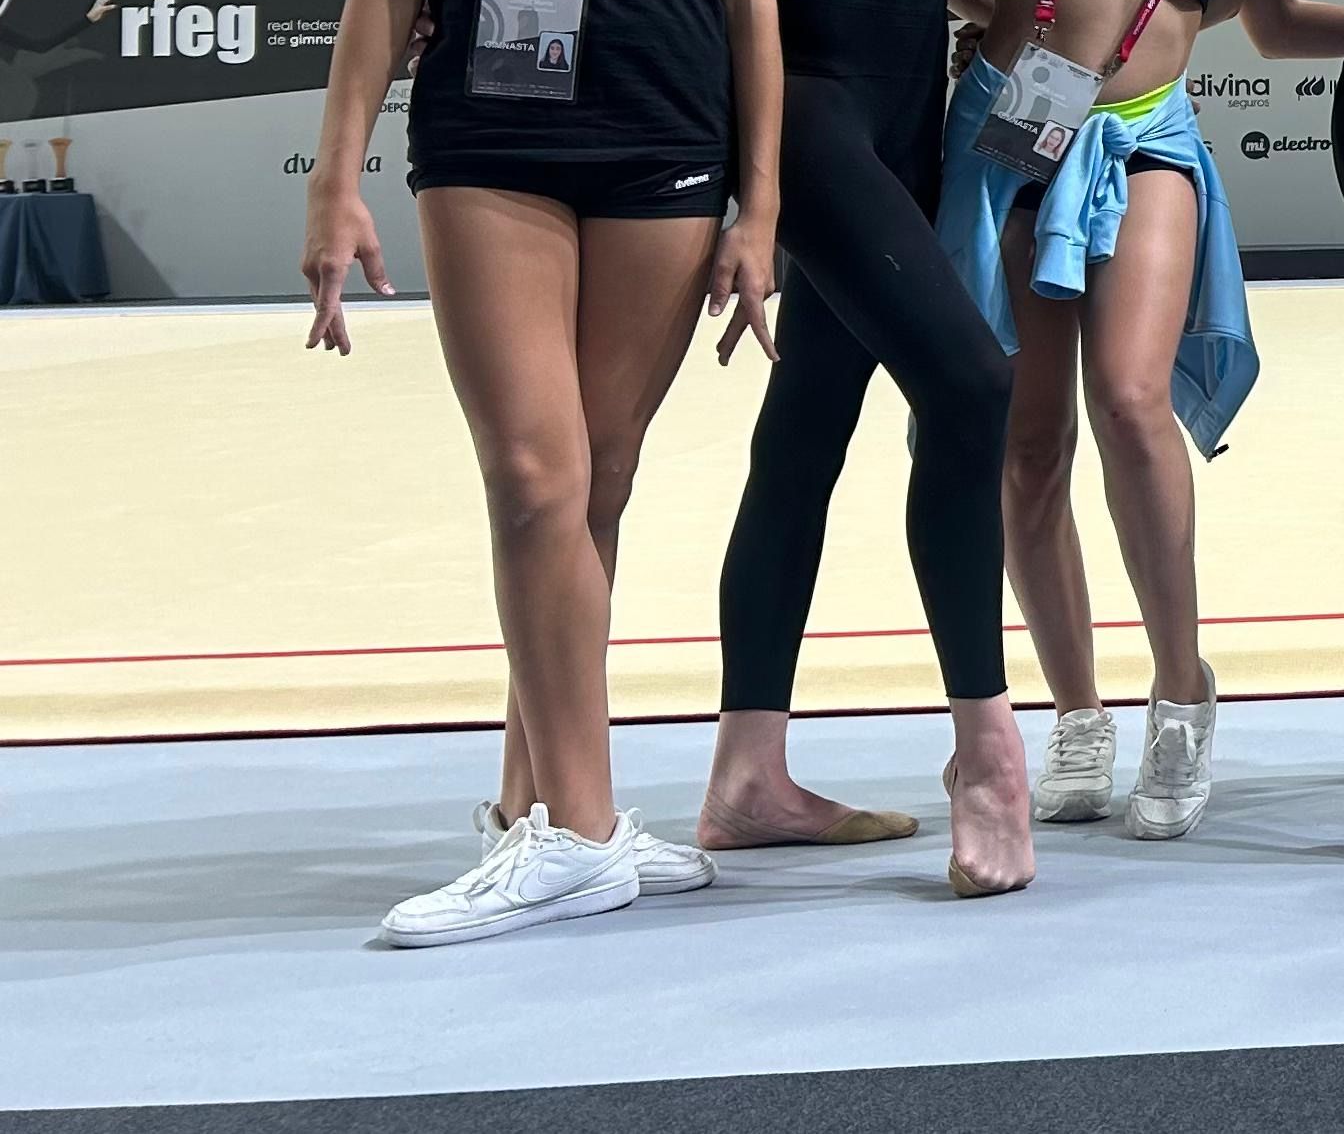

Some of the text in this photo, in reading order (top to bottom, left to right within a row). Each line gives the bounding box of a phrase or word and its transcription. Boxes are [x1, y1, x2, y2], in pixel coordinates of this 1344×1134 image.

[267, 20, 294, 32] real
[267, 35, 287, 47] de
[1191, 73, 1270, 97] divina
[1227, 98, 1270, 110] seguros
